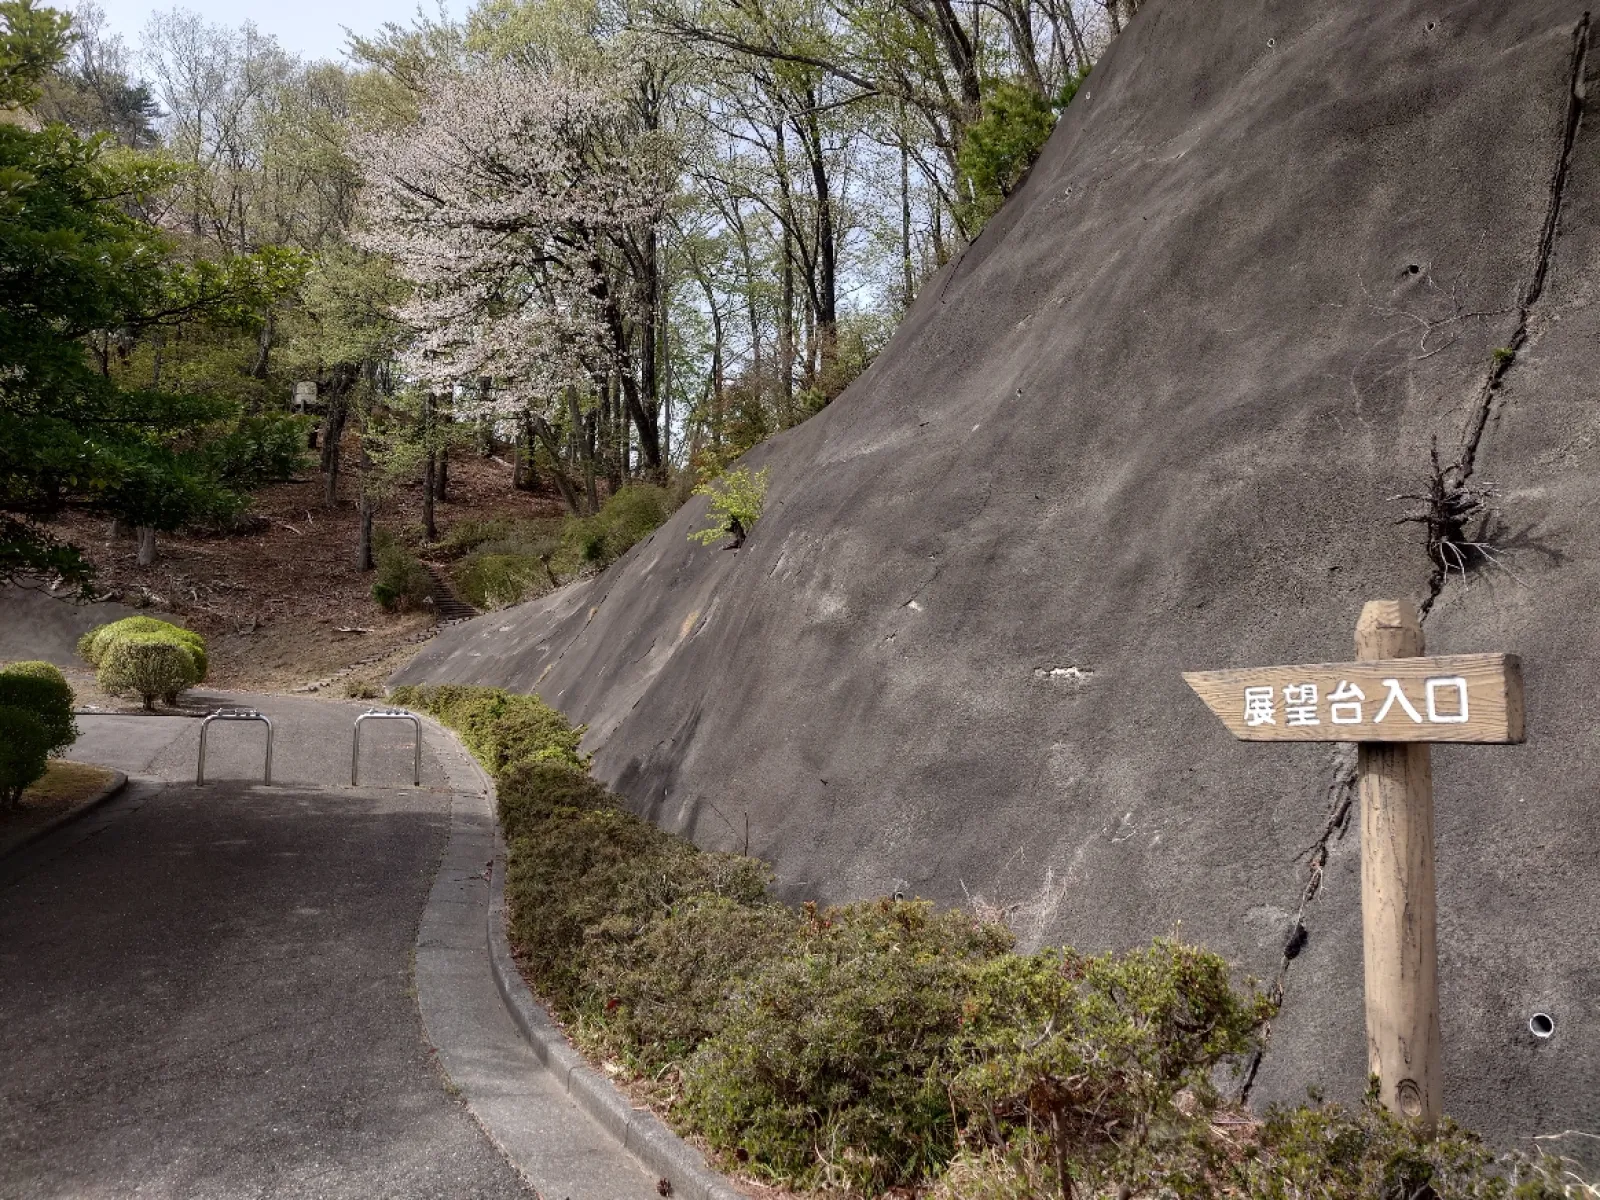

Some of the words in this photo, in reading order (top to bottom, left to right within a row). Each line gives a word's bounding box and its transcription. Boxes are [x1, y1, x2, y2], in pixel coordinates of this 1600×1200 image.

[1243, 677, 1469, 726] 展望台入口
